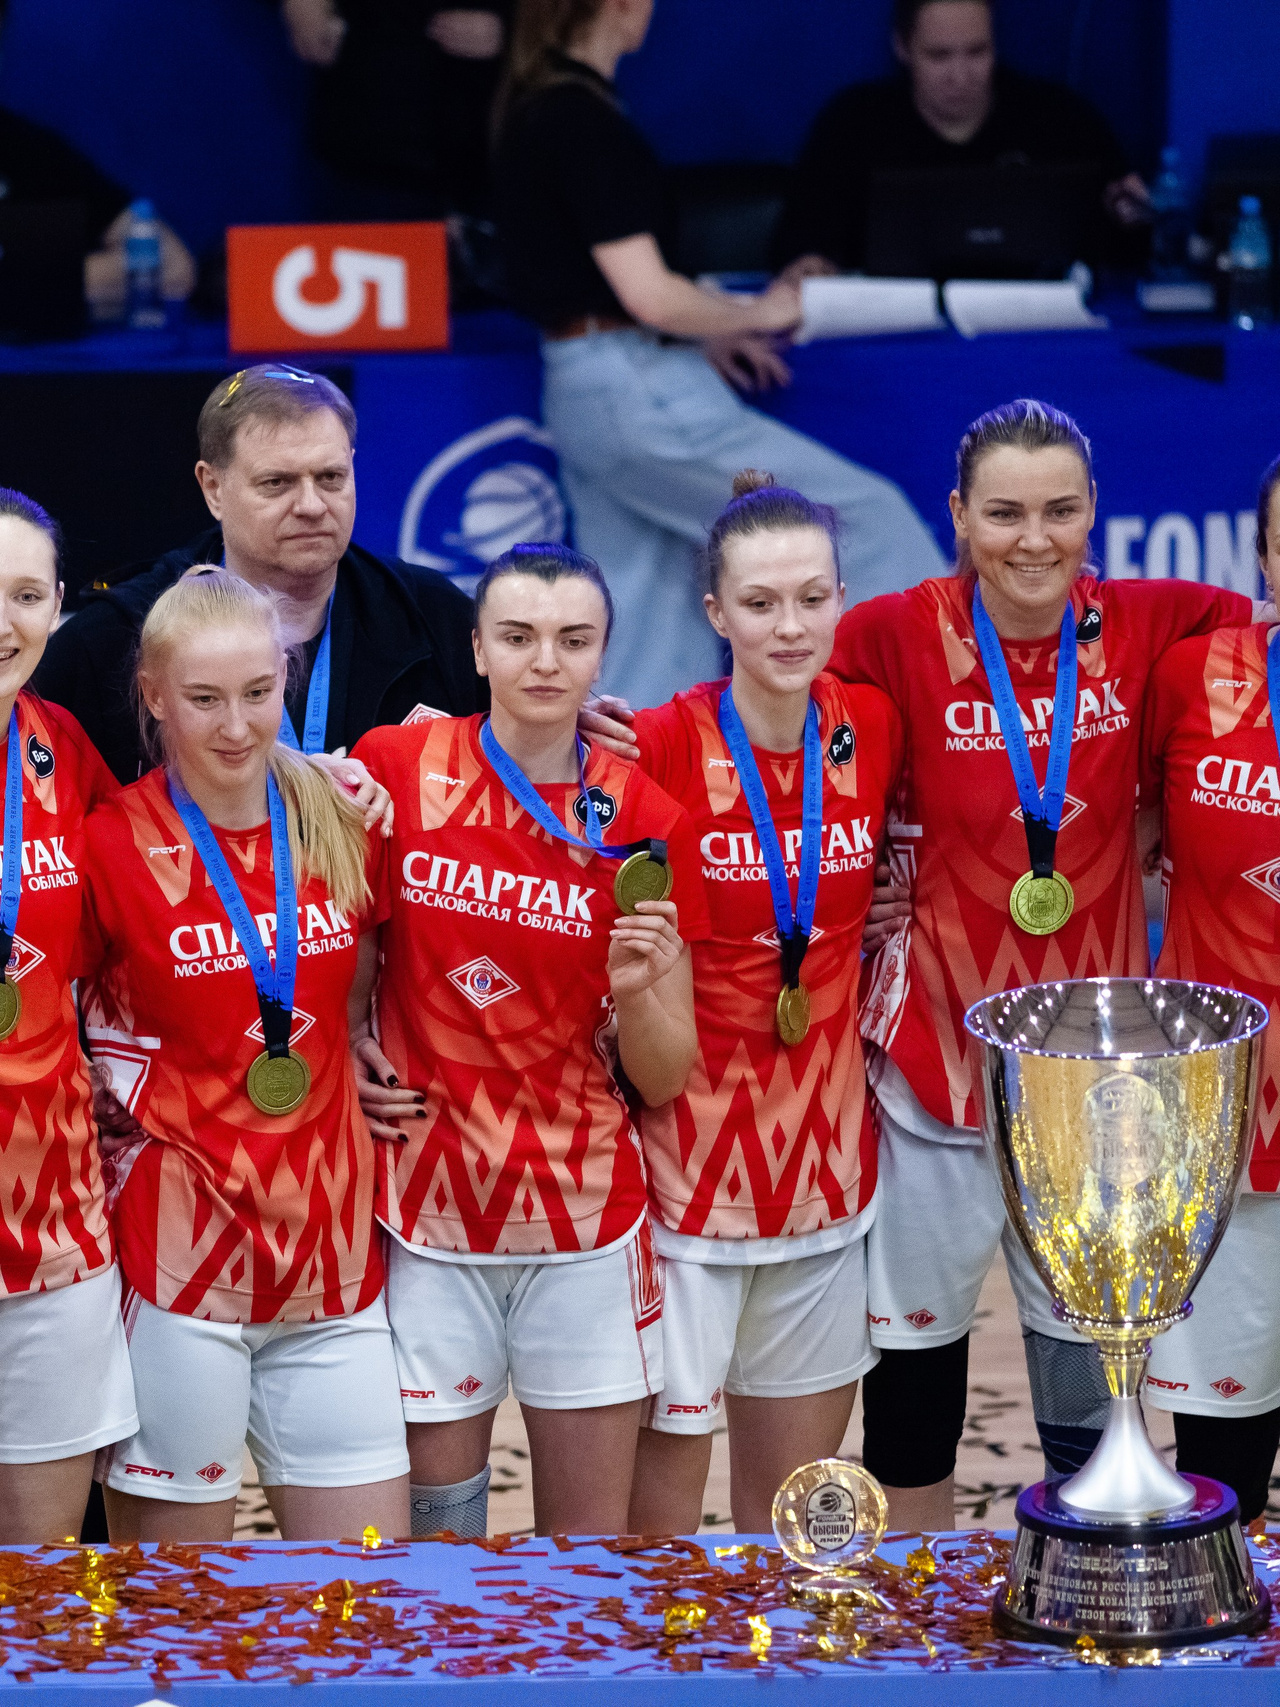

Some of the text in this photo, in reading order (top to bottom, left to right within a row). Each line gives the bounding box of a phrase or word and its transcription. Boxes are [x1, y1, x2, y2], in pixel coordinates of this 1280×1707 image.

[273, 244, 407, 337] 5
[945, 677, 1128, 735] СПРАК
[9, 825, 17, 854] FONBET
[700, 815, 874, 866] СПРАК
[8, 859, 16, 882] XXXIV
[27, 871, 78, 892] ОБЛАСТЬ
[402, 850, 597, 922] СПАРТАК
[211, 857, 228, 888] РОССИИ
[233, 905, 260, 955] БАСКЕТБОЛУ
[282, 897, 291, 928] FONBET
[399, 885, 592, 938] МОСКОВСКАЯ ОБЛАСТЬ
[282, 931, 291, 958] XXXIV
[297, 932, 354, 957] ОБЛАСТЬ
[813, 1524, 850, 1536] ВЫСШАЯ
[1143, 1580, 1156, 1592] ПО
[1075, 1609, 1106, 1621] СЕЗОН
